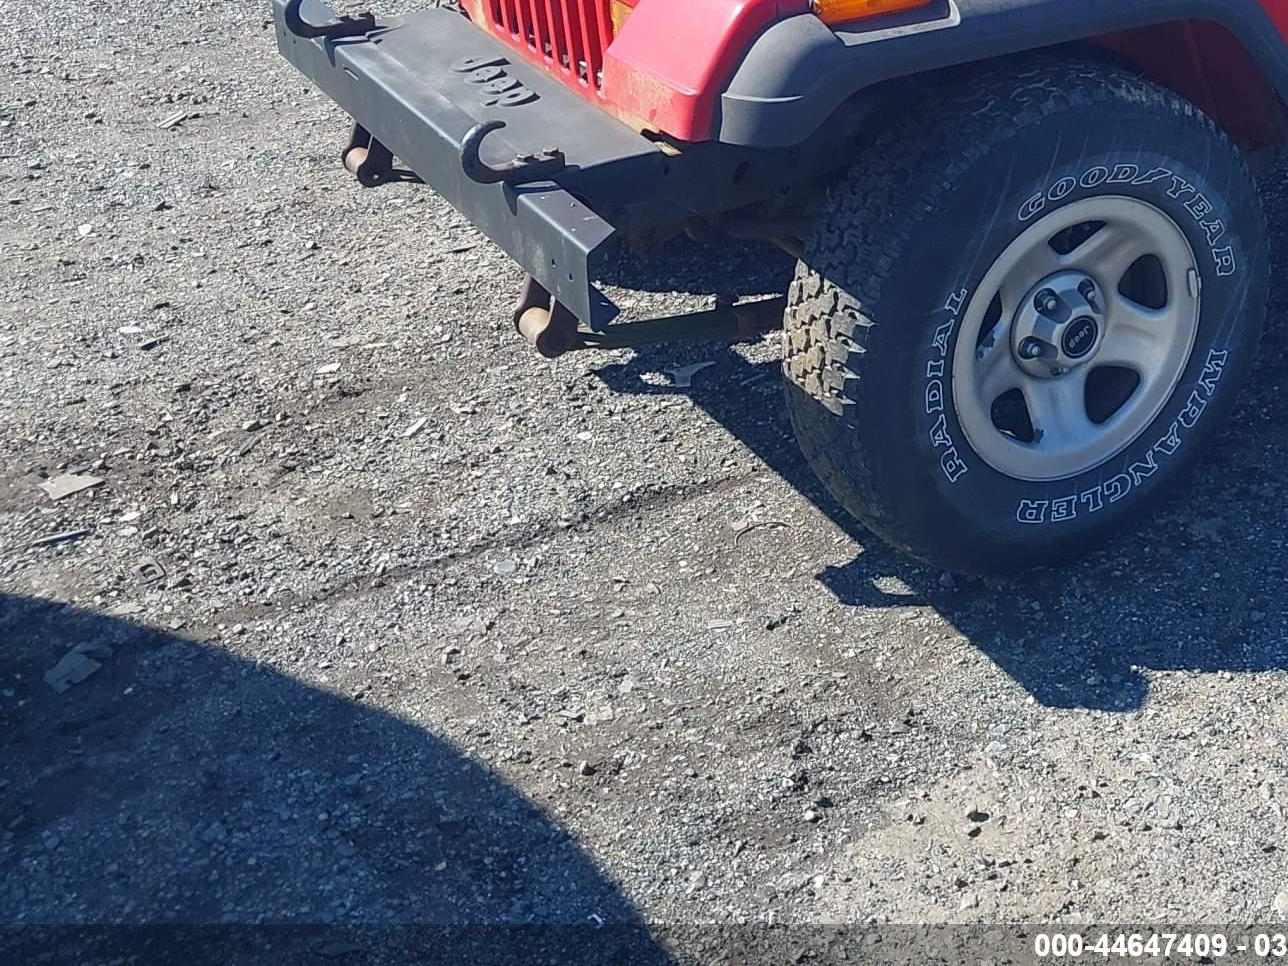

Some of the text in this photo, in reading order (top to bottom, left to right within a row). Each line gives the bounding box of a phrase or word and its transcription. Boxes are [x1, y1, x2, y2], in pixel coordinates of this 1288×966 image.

[448, 56, 543, 109] Jeep
[925, 287, 968, 483] RADIAL
[1068, 325, 1091, 348] Jeep
[1016, 348, 1229, 524] WRANGLER
